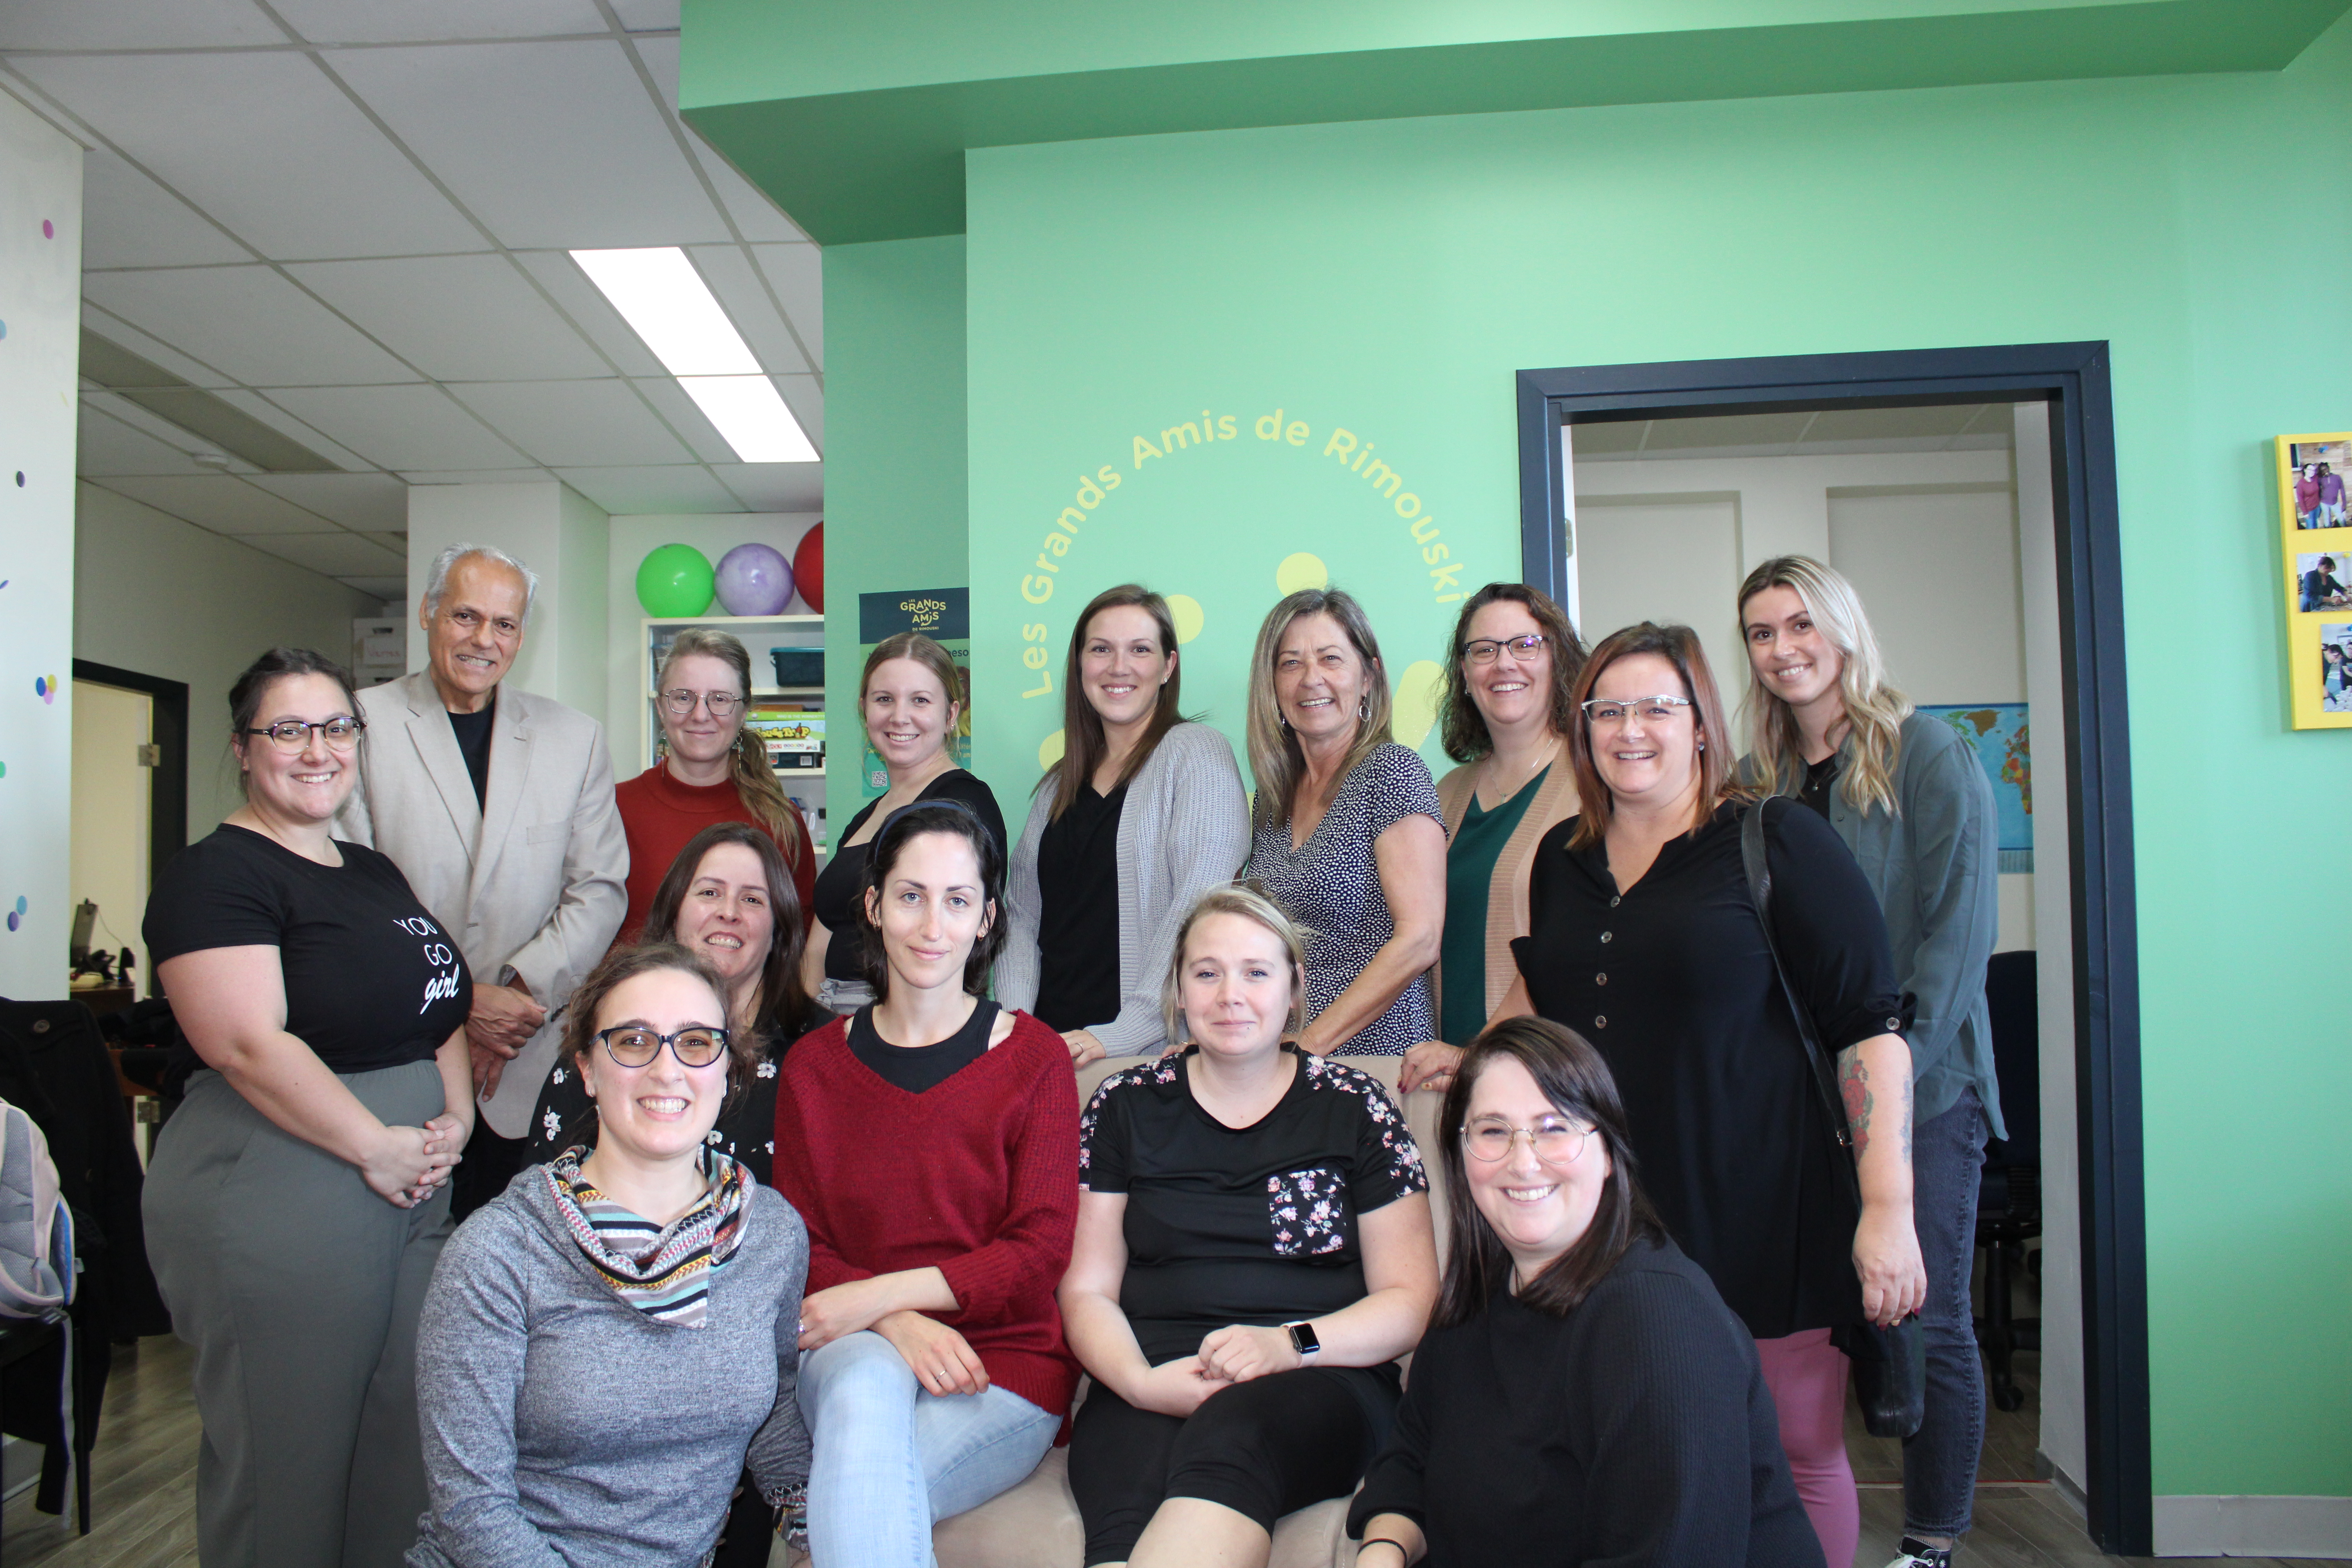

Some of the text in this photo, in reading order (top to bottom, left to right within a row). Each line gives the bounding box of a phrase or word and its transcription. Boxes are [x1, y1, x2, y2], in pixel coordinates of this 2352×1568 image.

[1021, 408, 1471, 699] Les Grands Amis de Rimouski
[900, 599, 947, 614] GRANDS
[392, 917, 438, 936] YOU
[424, 944, 452, 966] GO
[420, 963, 459, 1014] girl
